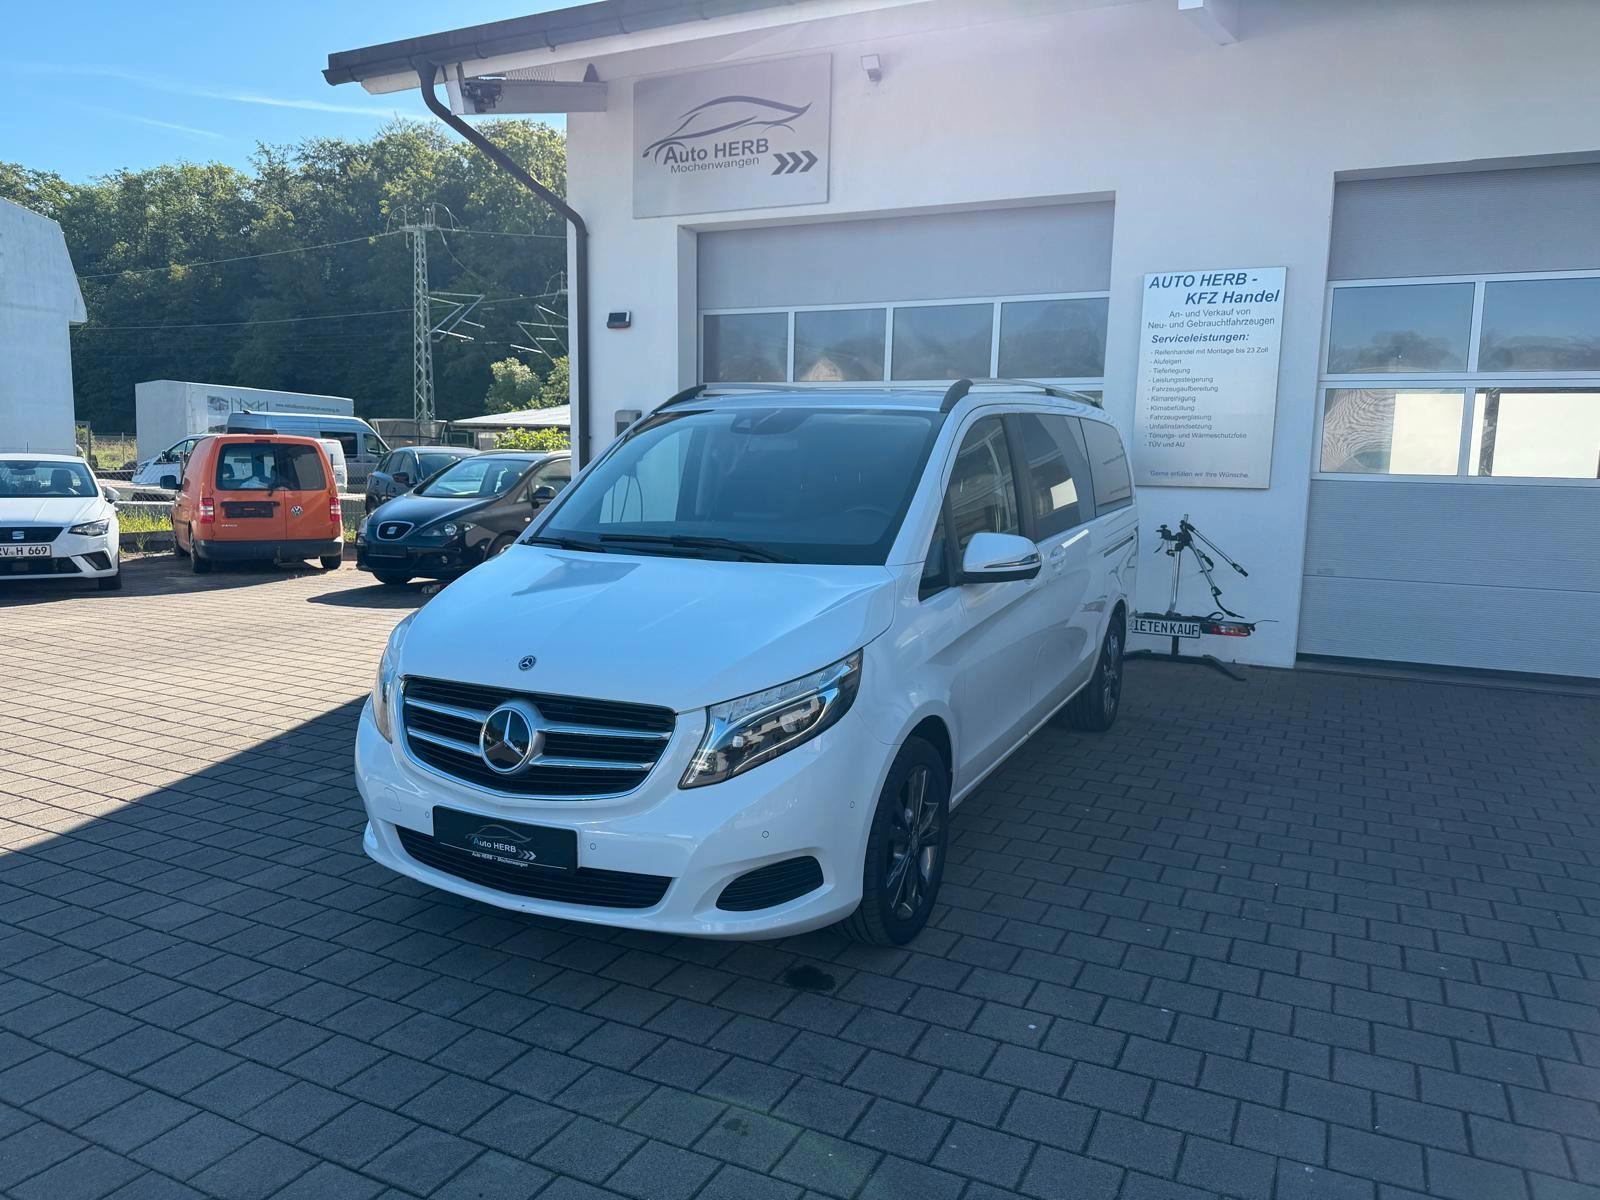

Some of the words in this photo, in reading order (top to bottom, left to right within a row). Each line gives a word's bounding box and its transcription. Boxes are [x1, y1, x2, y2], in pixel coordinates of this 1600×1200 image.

[663, 146, 708, 165] Auto
[714, 138, 768, 158] HERB
[671, 157, 759, 174] Mochenwangen
[1149, 274, 1195, 288] AUTO
[1200, 272, 1248, 286] HERB
[1185, 292, 1218, 304] KFZ
[1222, 289, 1280, 304] Handel
[1185, 310, 1200, 318] und
[1202, 308, 1234, 316] Verkauf
[1169, 320, 1184, 328] und
[1186, 318, 1274, 328] Gebrauchtfahrzeugen
[1152, 333, 1250, 344] Serviceleistungen:
[16, 546, 23, 555] H
[28, 546, 47, 555] 669
[474, 838, 492, 848] Auto
[494, 842, 516, 853] HERB
